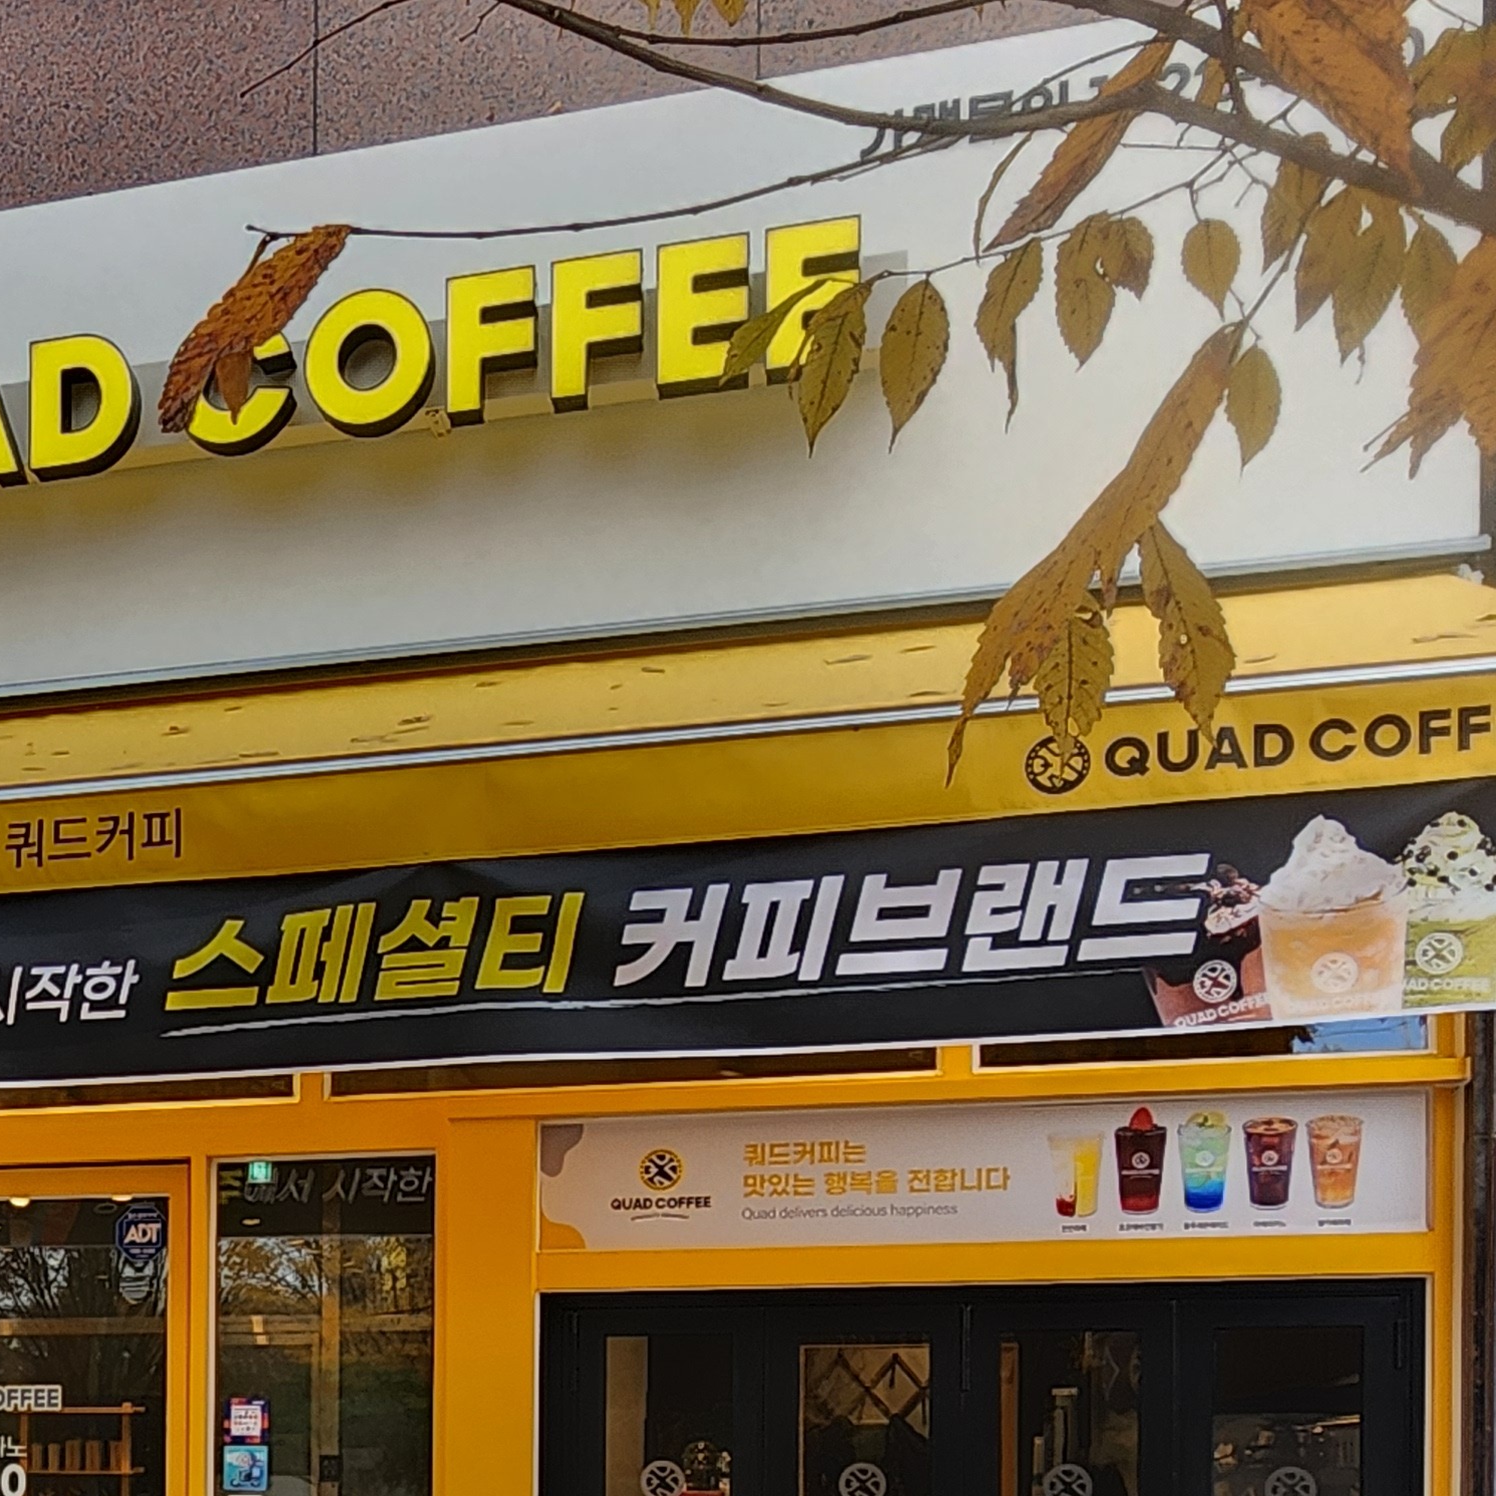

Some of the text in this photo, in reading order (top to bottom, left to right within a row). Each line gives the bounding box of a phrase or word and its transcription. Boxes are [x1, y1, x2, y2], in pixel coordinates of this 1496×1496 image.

[1104, 704, 1492, 777] QUAD COFF
[4, 806, 184, 870] 쿼드커피
[164, 891, 584, 1012] 스페셜티
[613, 853, 1210, 988] 커피브랜드
[1173, 1008, 1216, 1027] QUAD
[743, 1140, 867, 1167] 쿼드커피는
[743, 1166, 1011, 1198] 맛있는 행복을 전합니다
[610, 1195, 712, 1211] QUAD COFFEE
[742, 1203, 958, 1221] Quad delivers delicious happiness
[123, 1222, 162, 1244] ADT
